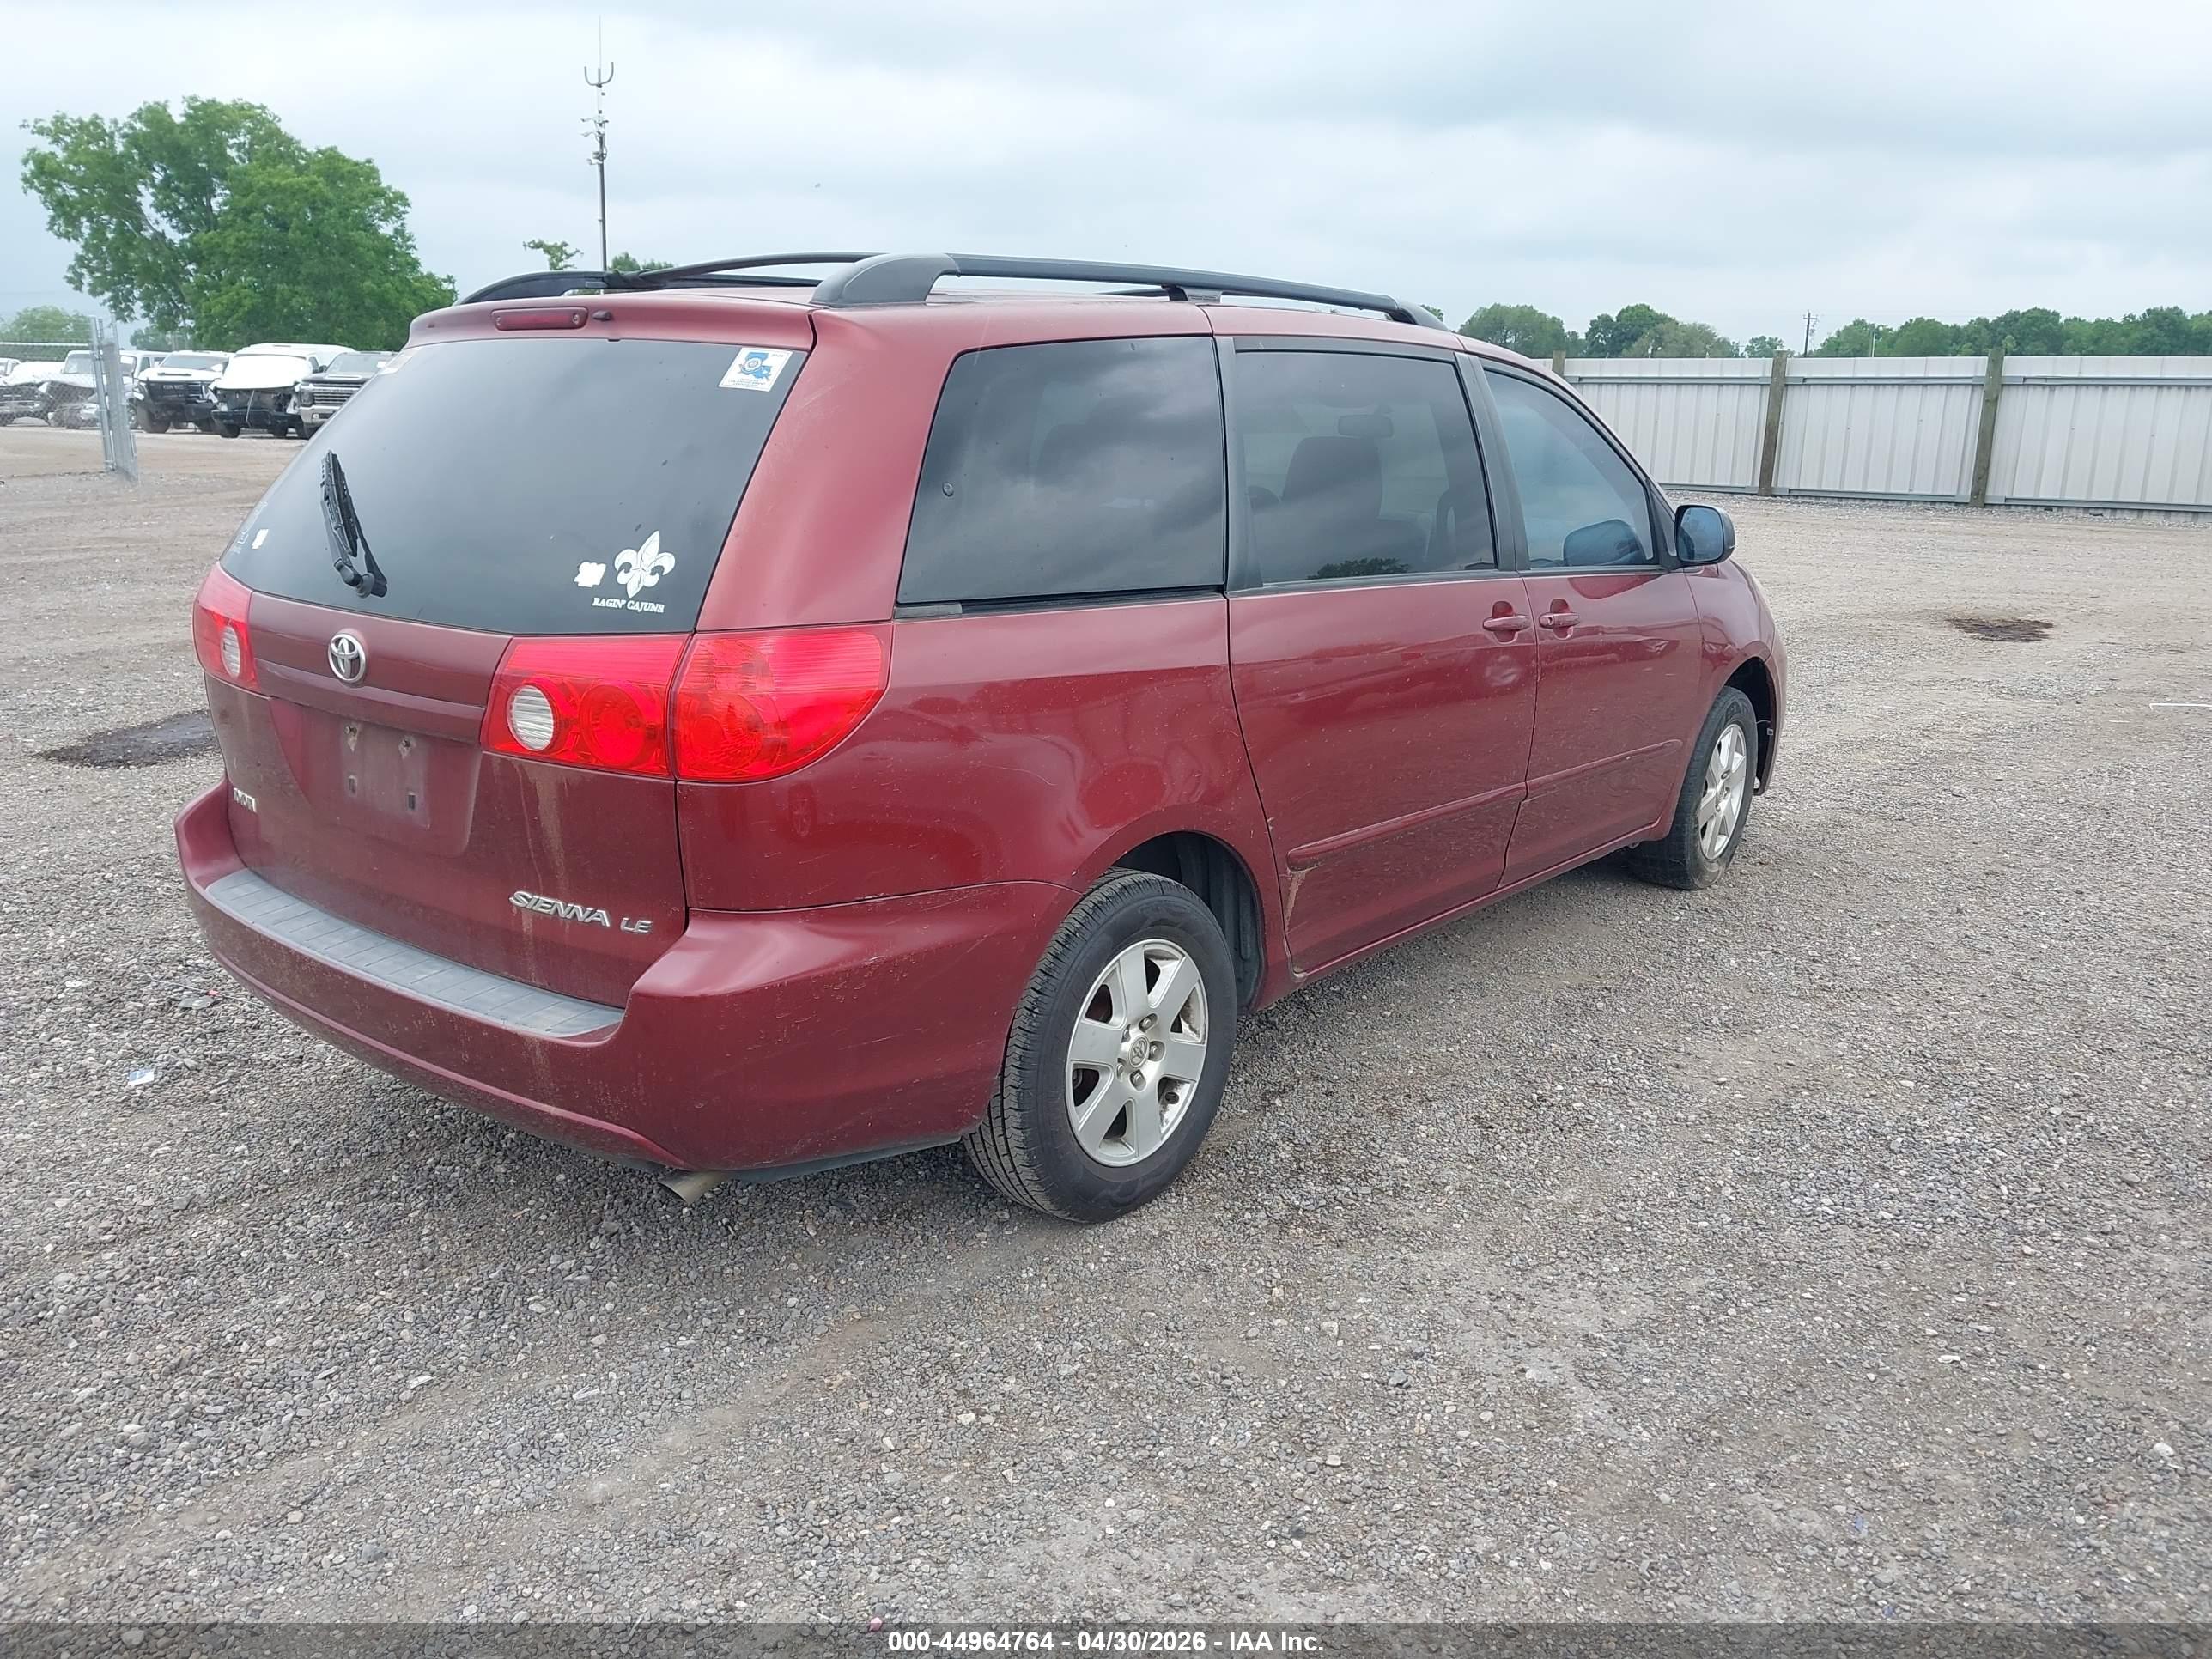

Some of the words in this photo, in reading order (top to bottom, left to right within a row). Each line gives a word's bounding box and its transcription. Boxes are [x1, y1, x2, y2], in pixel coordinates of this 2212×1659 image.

[592, 597, 627, 609] RAGIN'
[627, 600, 665, 614] CAJUNS
[508, 890, 611, 928] SIENNA
[619, 917, 653, 934] LE
